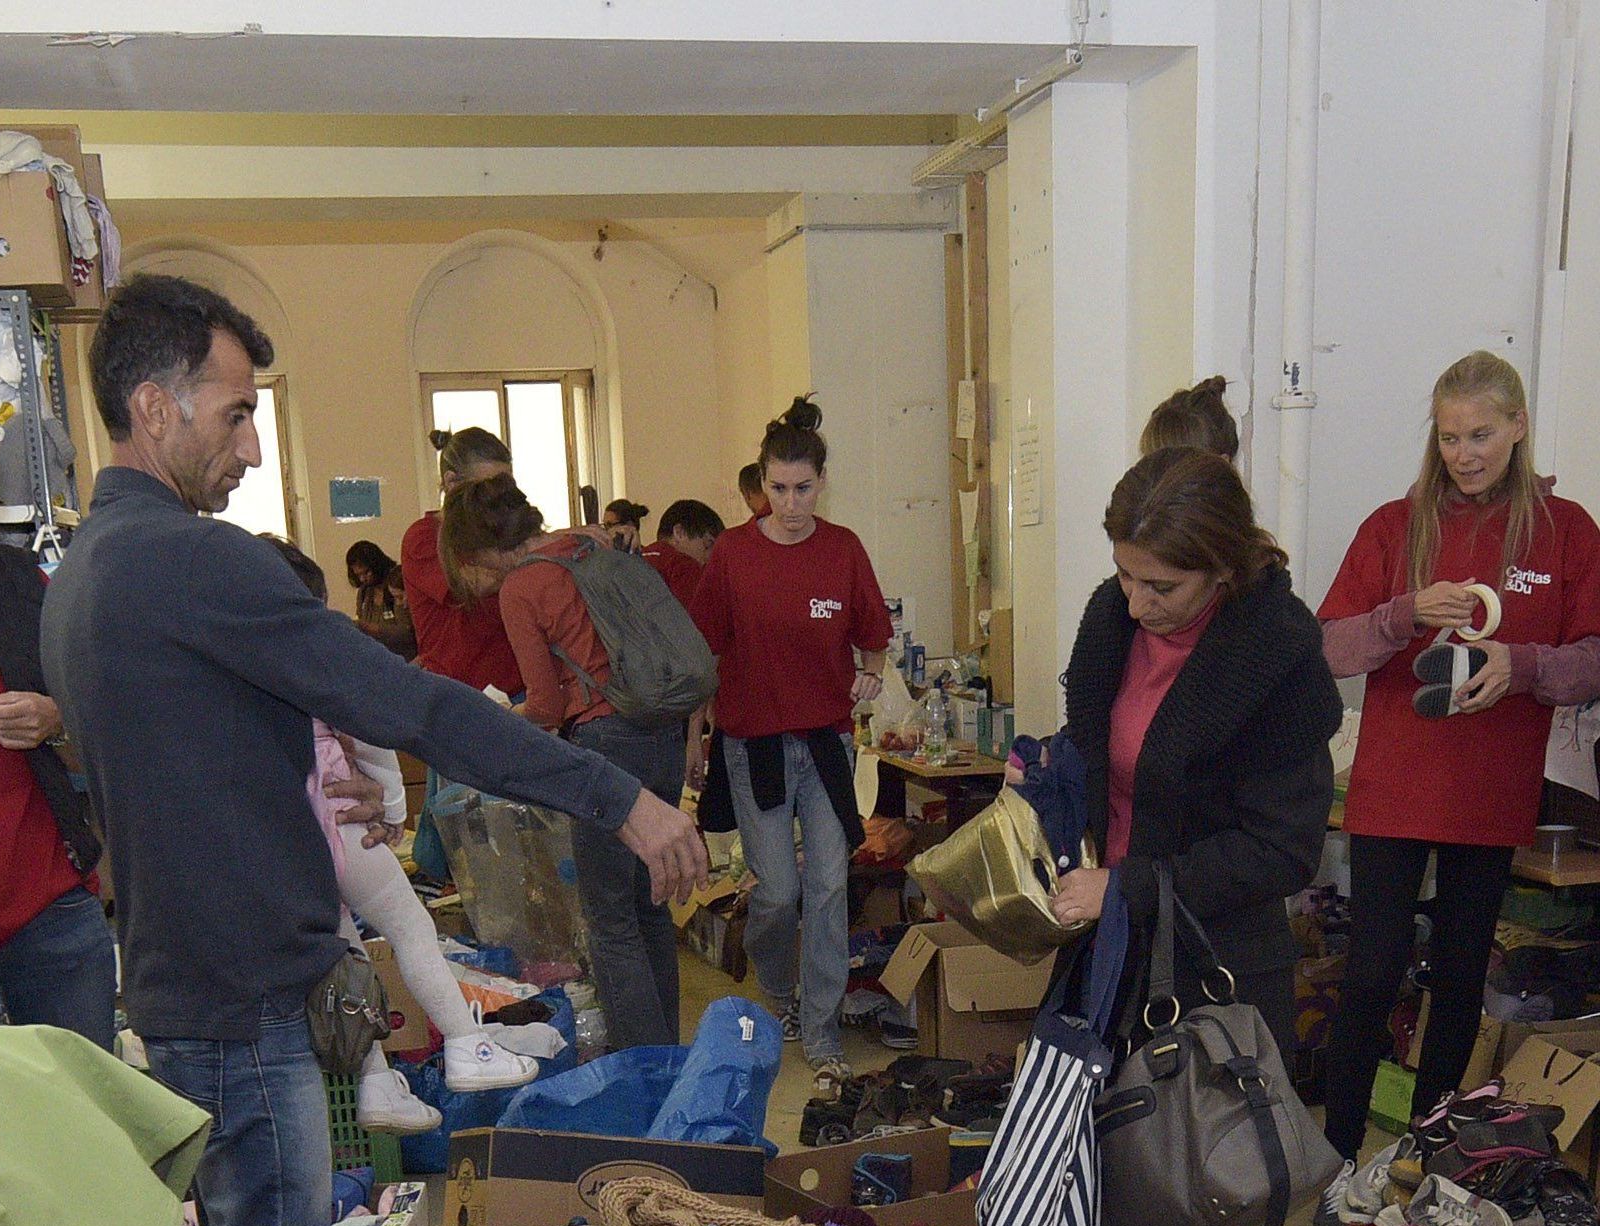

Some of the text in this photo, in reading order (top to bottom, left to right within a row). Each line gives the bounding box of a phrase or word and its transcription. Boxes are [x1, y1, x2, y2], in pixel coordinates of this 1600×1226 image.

[1505, 565, 1552, 585] Caritas
[1504, 578, 1533, 595] &Du
[810, 607, 832, 619] &Du
